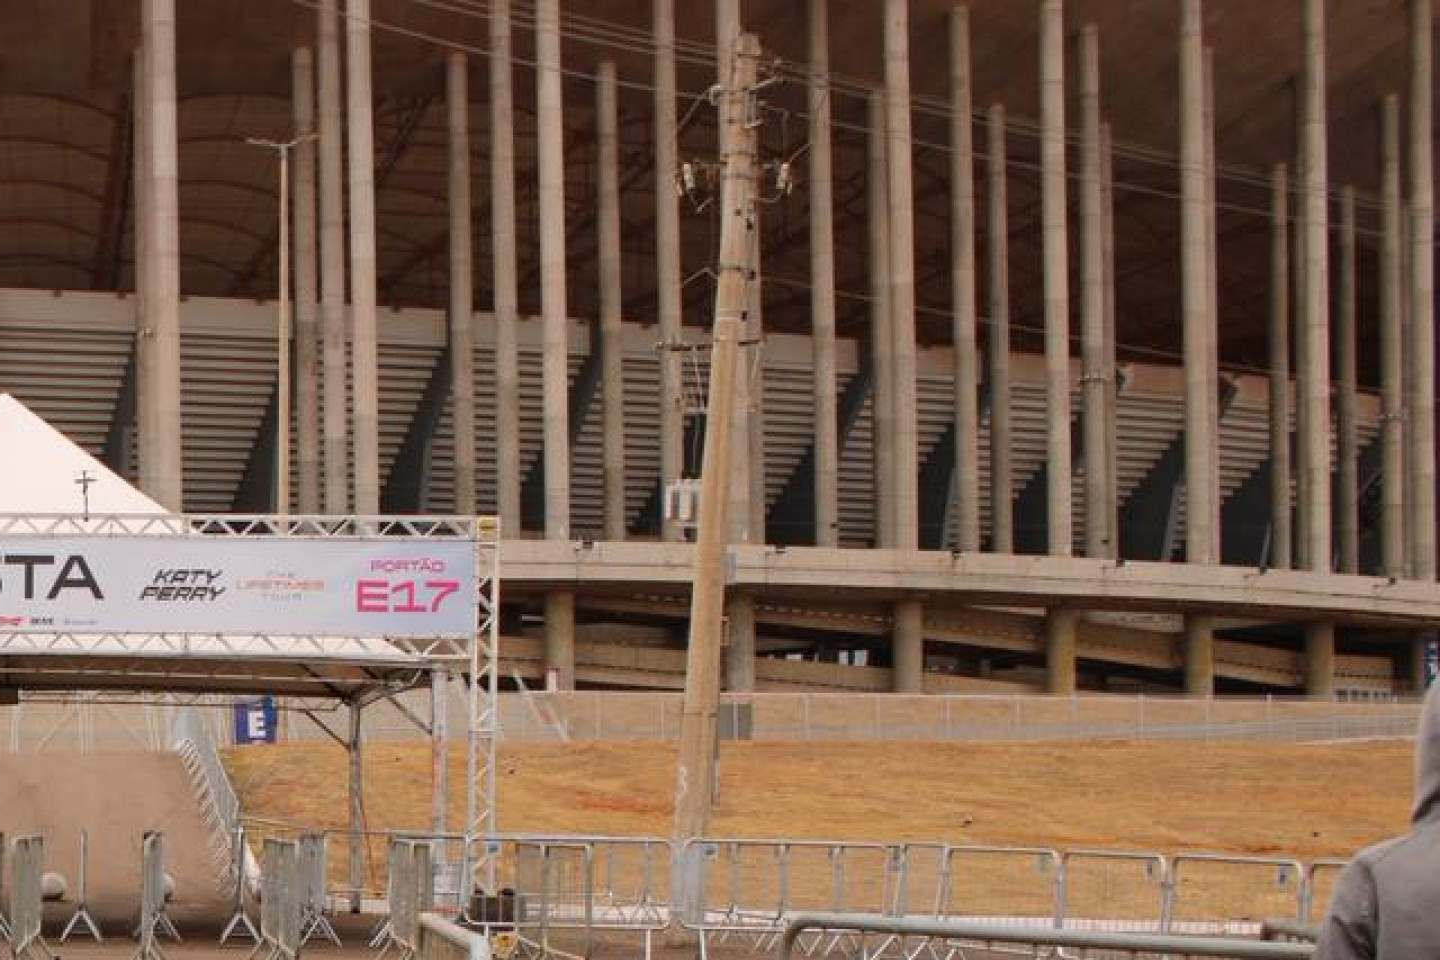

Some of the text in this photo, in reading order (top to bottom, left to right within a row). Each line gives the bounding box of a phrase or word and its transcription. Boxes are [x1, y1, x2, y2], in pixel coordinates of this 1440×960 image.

[371, 557, 444, 572] PORTÃO
[152, 568, 223, 584] KATY
[139, 586, 226, 601] PERRY
[357, 580, 460, 613] E17
[249, 711, 266, 738] E
